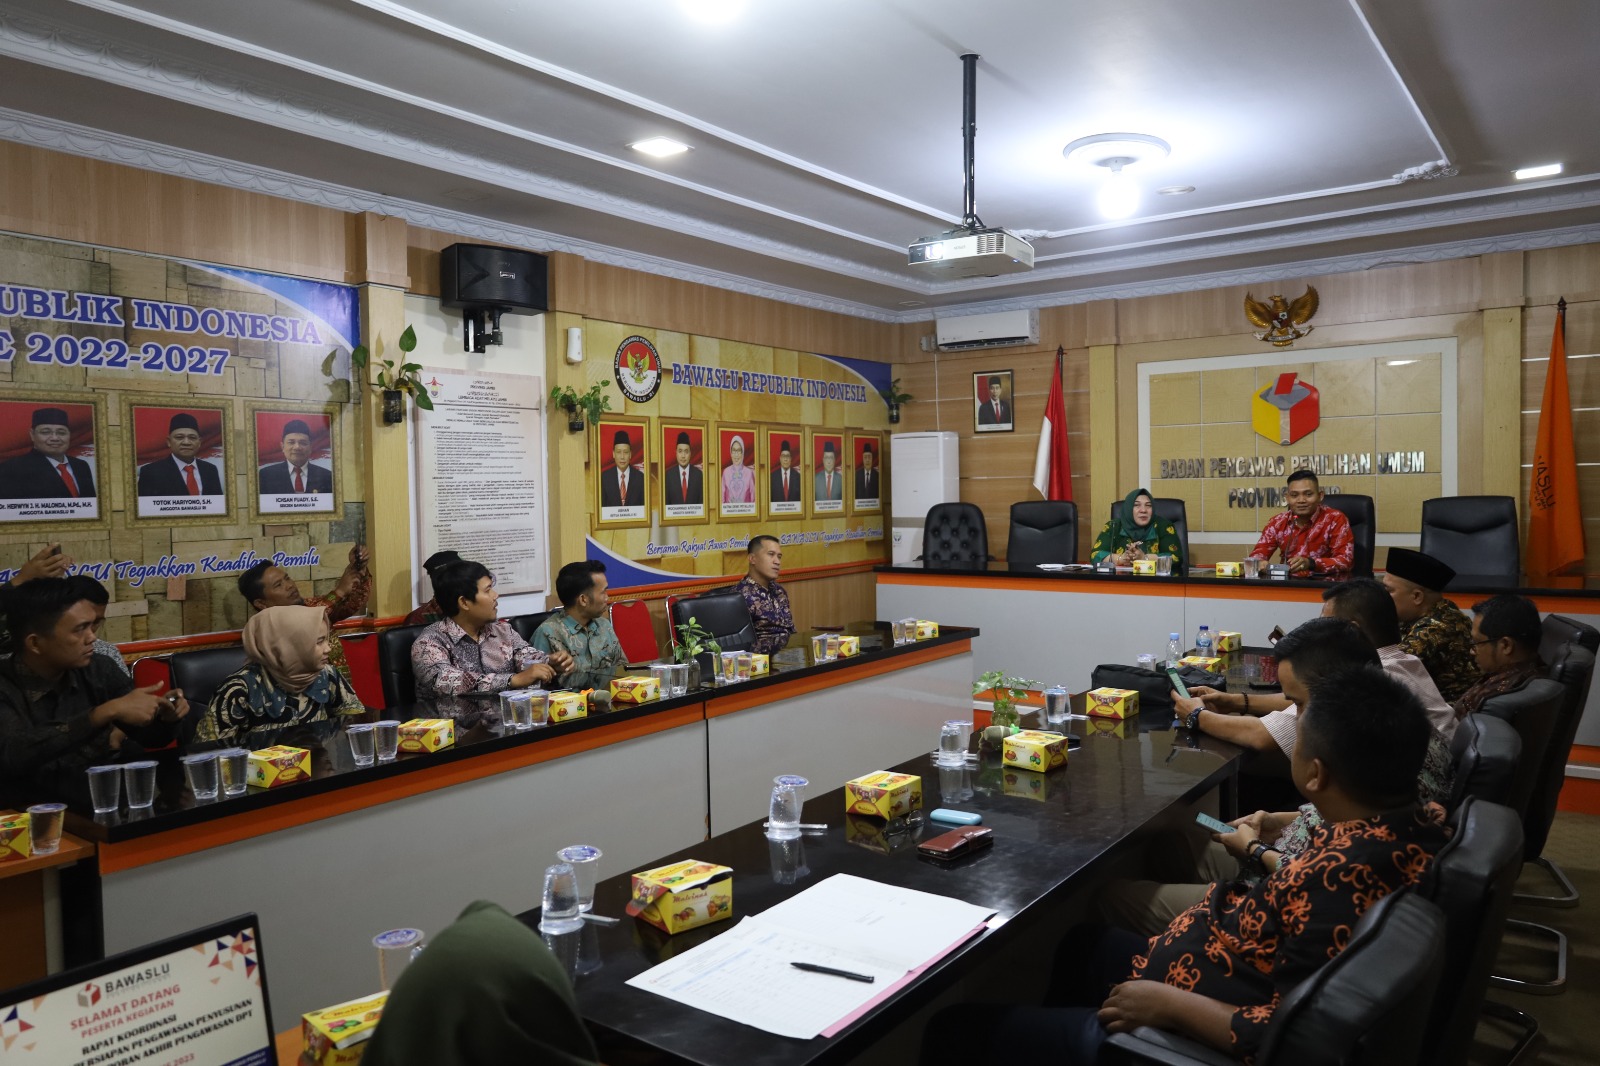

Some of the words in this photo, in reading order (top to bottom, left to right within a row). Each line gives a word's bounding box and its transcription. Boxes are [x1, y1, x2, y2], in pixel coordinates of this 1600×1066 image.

[134, 300, 322, 345] INDONESIA
[27, 333, 230, 375] 2022-2027
[672, 362, 739, 390] BAWASLU
[742, 371, 804, 397] REPUBLIK
[807, 379, 867, 403] INDONESIA
[1161, 458, 1205, 479] BADAN
[1210, 455, 1285, 478] PENGAWAS
[1290, 452, 1371, 475] PEMILIHAN
[1377, 451, 1425, 474] UMUM
[1228, 487, 1288, 509] PROVINS
[646, 542, 679, 556] Bersama
[681, 537, 707, 558] Rakyat
[708, 538, 728, 551] Awasi
[780, 531, 819, 545] BAWASLU
[115, 554, 196, 587] Tegakkan
[200, 550, 267, 573] Keadila
[272, 546, 320, 568] Pemilu
[105, 963, 170, 993] BAWASLU
[70, 1002, 127, 1030] SELAMAT
[131, 984, 181, 1009] DATANG
[81, 1018, 124, 1039] PESERTA
[126, 999, 174, 1022] KEGIATAN
[132, 1020, 195, 1050] PENGAWASAN
[196, 998, 253, 1025] PENYUSUNAN
[82, 1037, 114, 1056] RAPAT
[117, 1014, 177, 1042] KOORDINASI
[143, 1040, 173, 1058] AKHIR
[174, 1018, 234, 1046] PENGAWASAN
[235, 1009, 253, 1022] DPT
